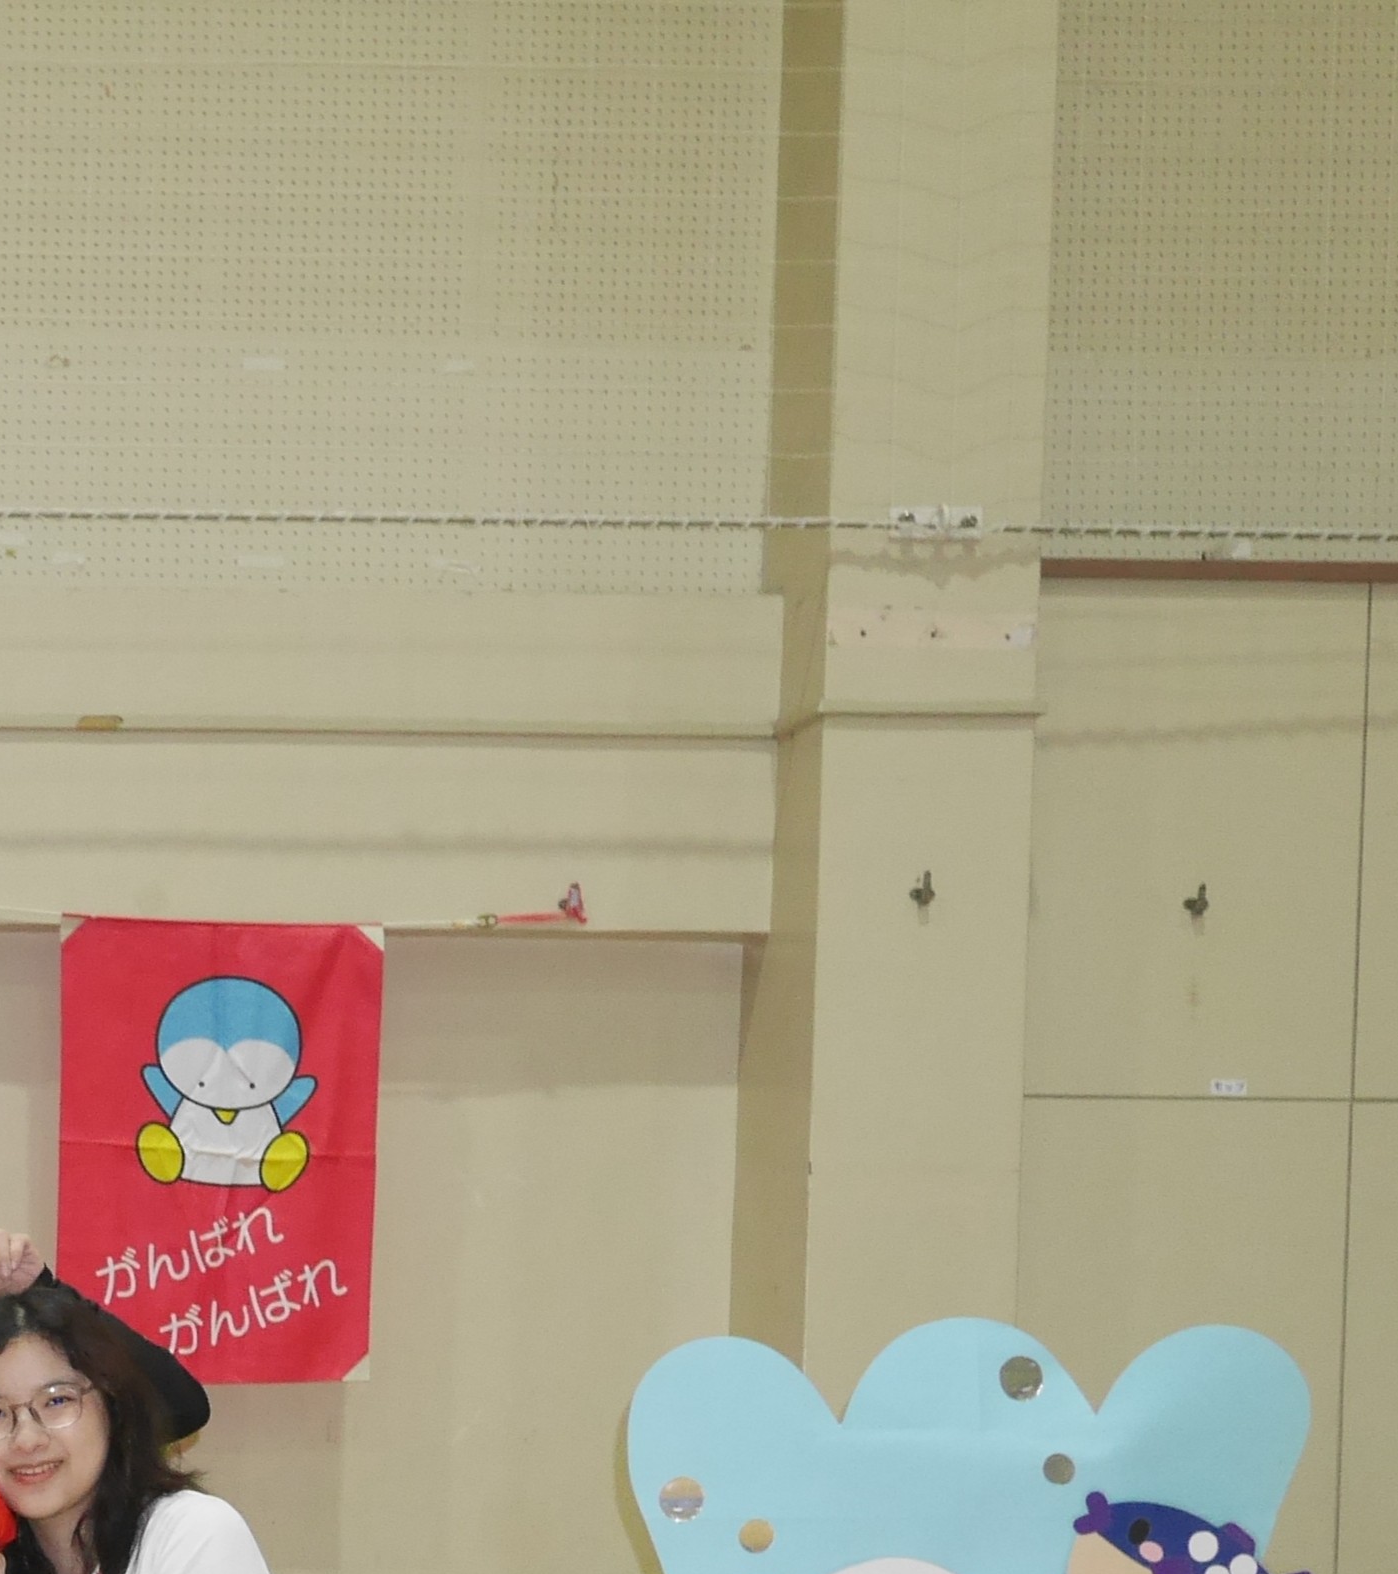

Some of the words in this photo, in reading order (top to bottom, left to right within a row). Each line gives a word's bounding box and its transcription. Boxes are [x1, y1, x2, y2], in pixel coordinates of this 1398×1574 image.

[96, 1206, 284, 1304] がんばれ
[160, 1259, 348, 1355] がんばれ
